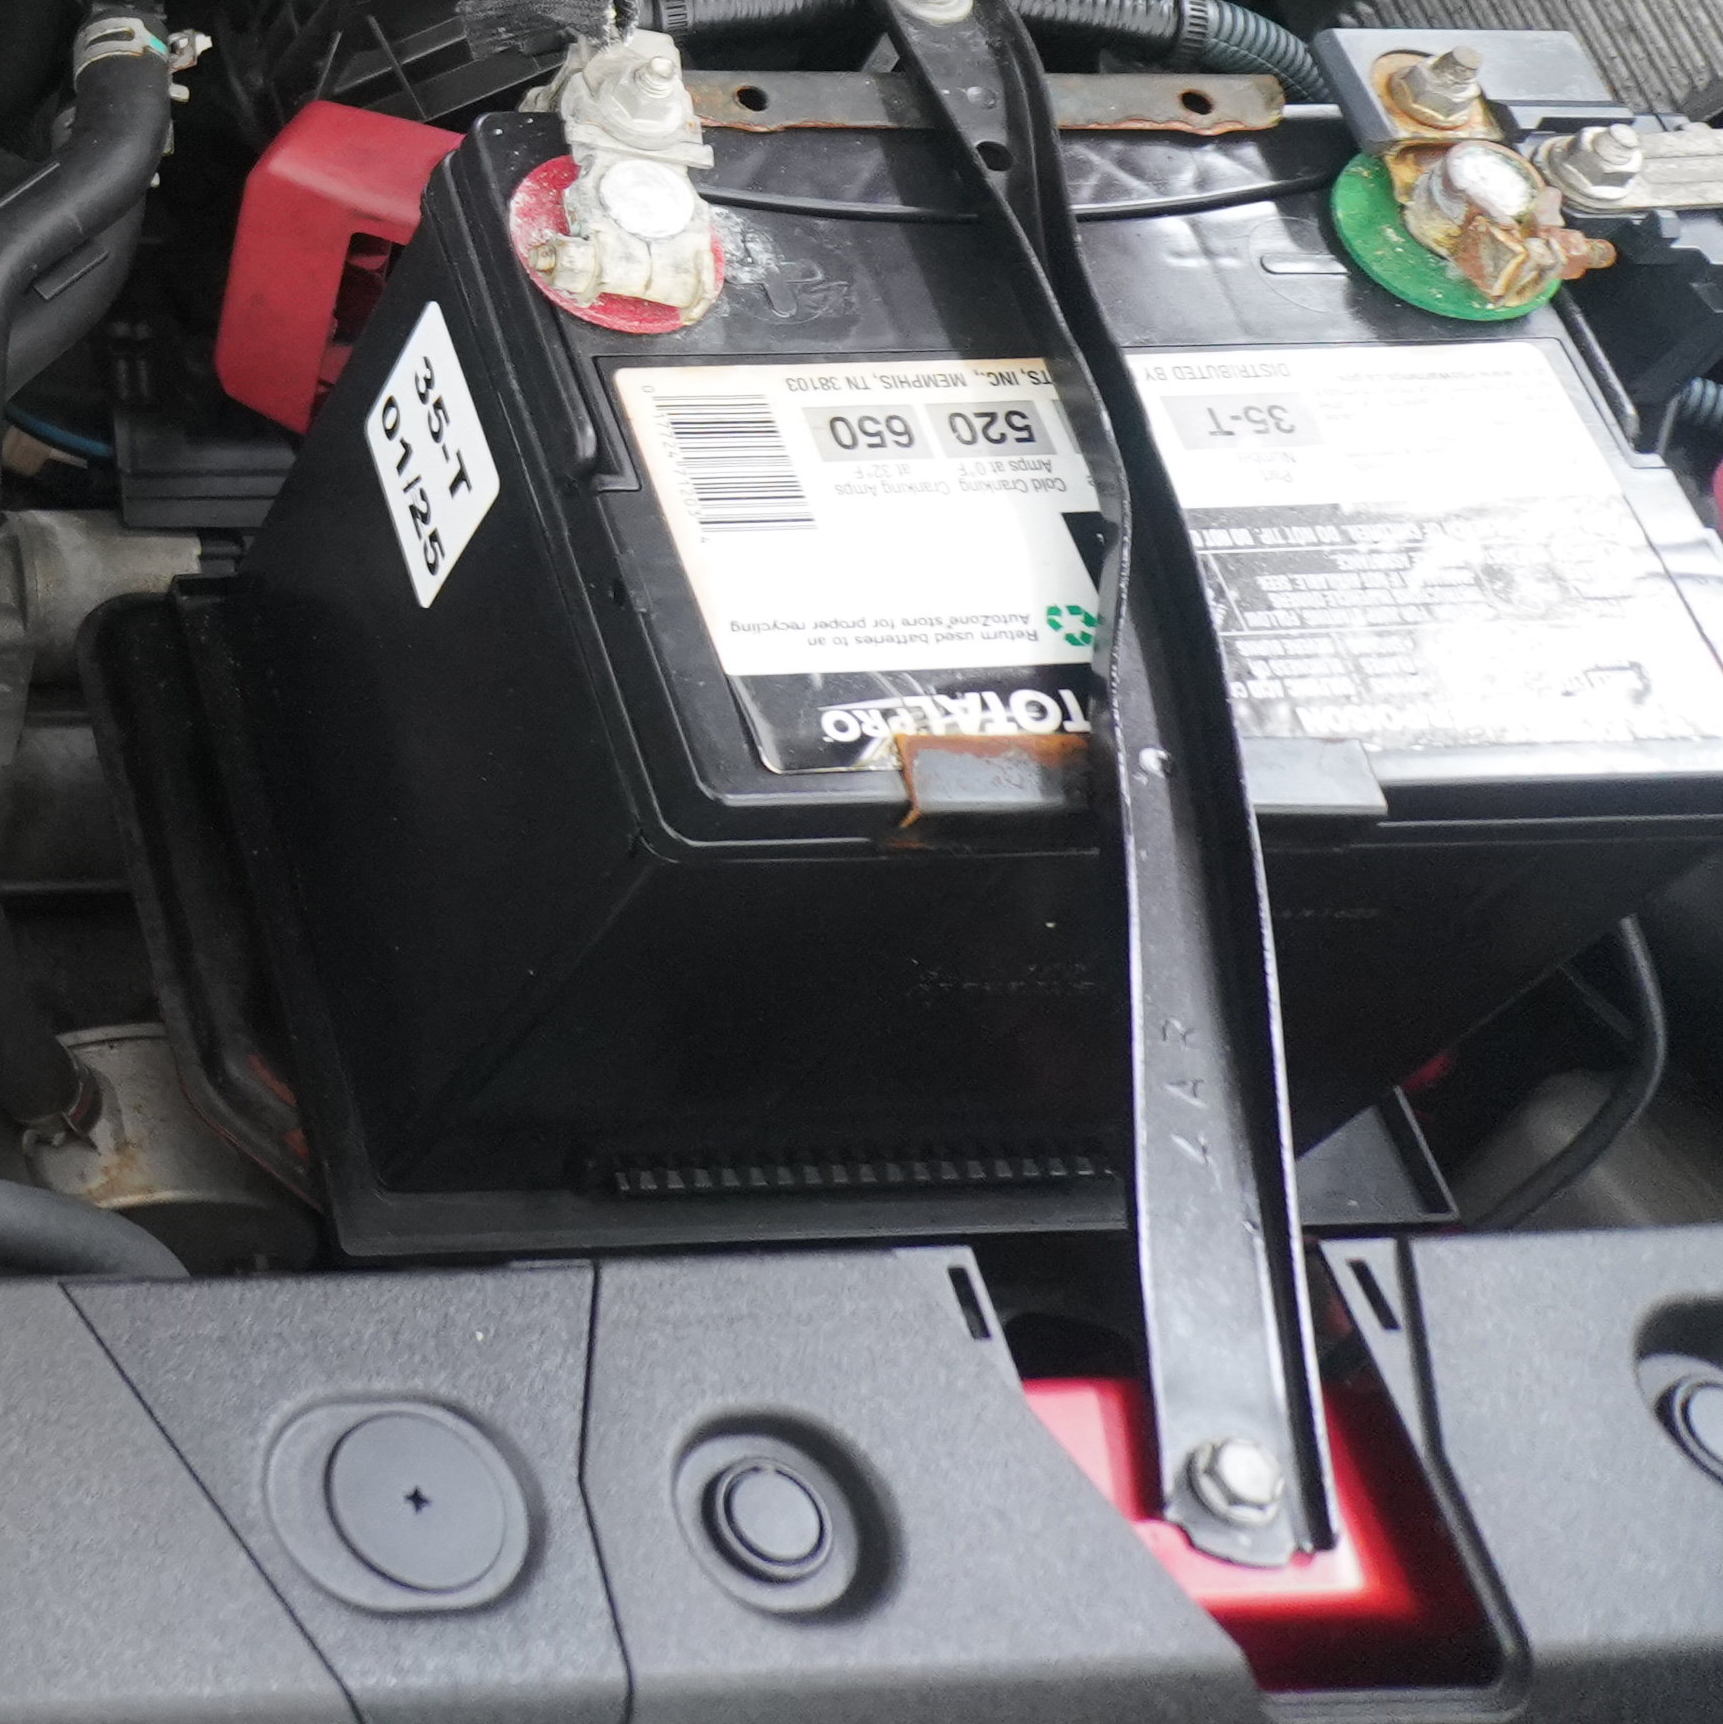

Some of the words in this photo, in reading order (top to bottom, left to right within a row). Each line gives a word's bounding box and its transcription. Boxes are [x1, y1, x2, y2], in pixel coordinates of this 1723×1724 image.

[1143, 363, 1169, 382] BY
[1171, 361, 1292, 381] DISTRIBUTED
[786, 377, 840, 392] 38103
[845, 376, 872, 391] TN
[873, 372, 968, 389] MEMPHIS,
[414, 356, 472, 500] 35-T
[947, 409, 1038, 447] 520
[1205, 404, 1298, 437] 35-T
[829, 415, 916, 451] 650
[896, 463, 911, 476] at
[990, 460, 1004, 474] at
[1009, 458, 1052, 474] Amps
[833, 481, 878, 497] Amps
[881, 480, 952, 496] Cranking
[958, 477, 1028, 495] Cranking
[1032, 477, 1068, 494] Cold
[729, 618, 806, 635] recycling
[812, 614, 867, 632] proper
[873, 618, 896, 631] for
[900, 616, 944, 630] store
[807, 636, 827, 647] an
[833, 635, 849, 647] to
[855, 633, 929, 647] batteries
[935, 631, 974, 645] used
[980, 629, 1039, 643] Return
